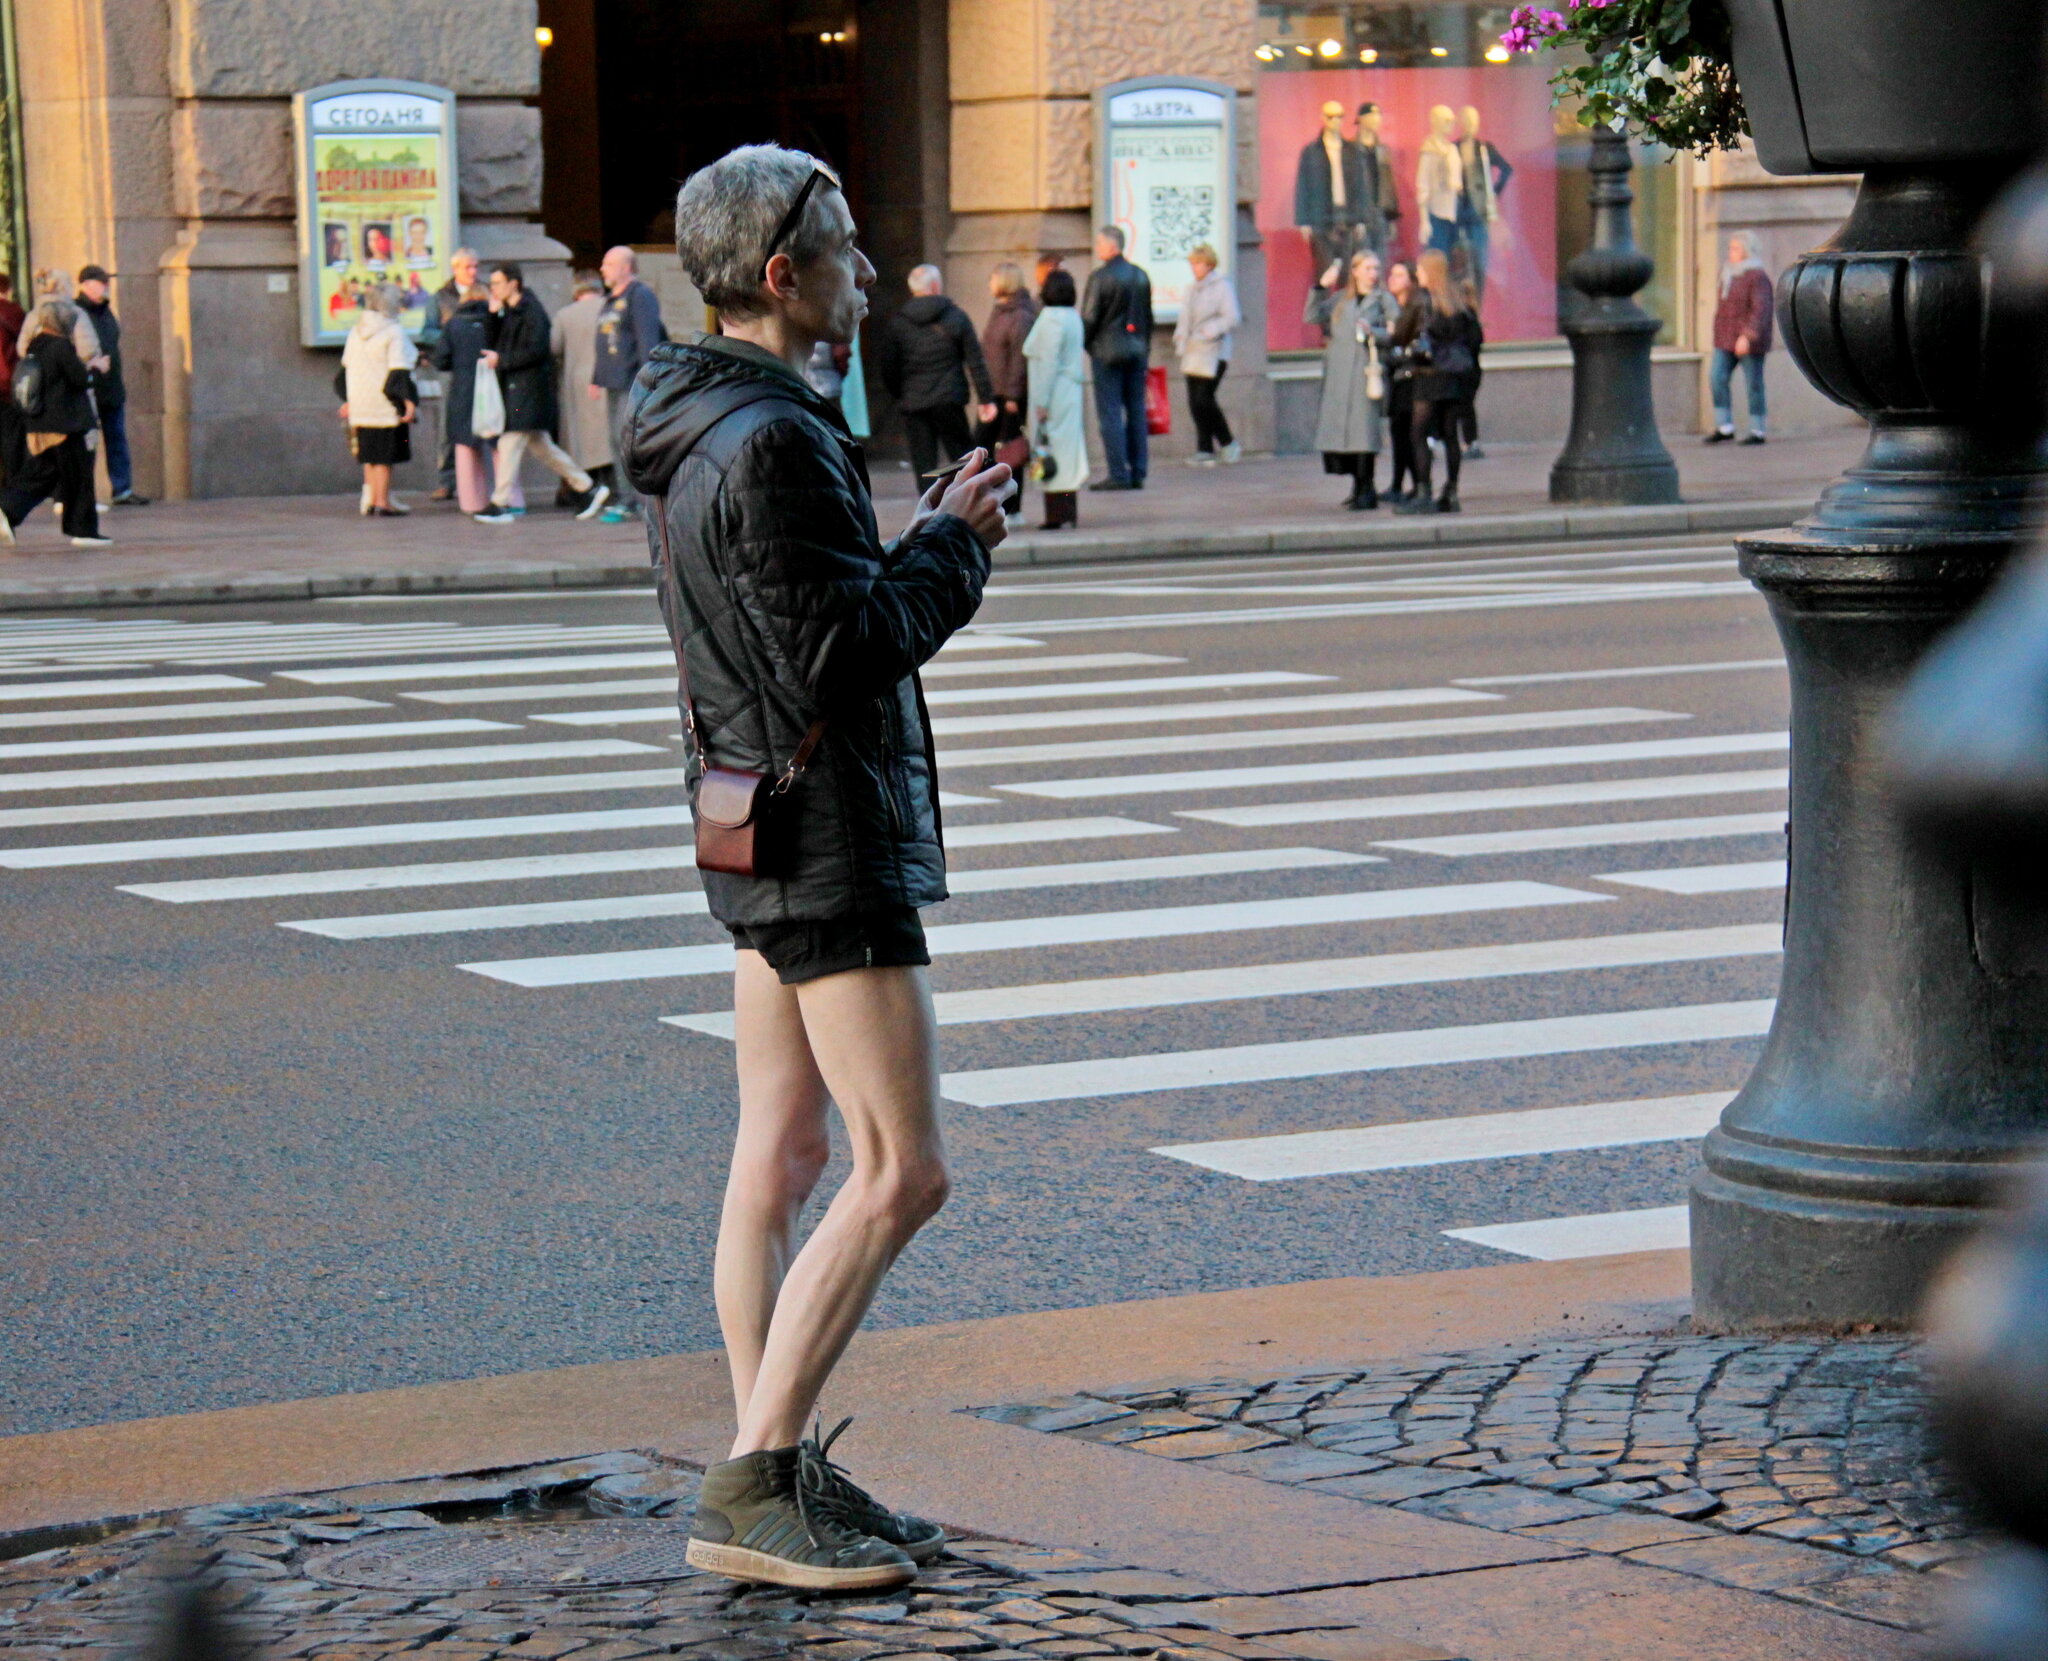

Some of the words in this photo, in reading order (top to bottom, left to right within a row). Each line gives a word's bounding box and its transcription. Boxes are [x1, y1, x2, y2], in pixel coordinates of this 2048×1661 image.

[329, 108, 423, 124] СЕГОДНЯ
[1131, 102, 1194, 117] ЗАВТРА
[693, 1550, 724, 1565] adidas
